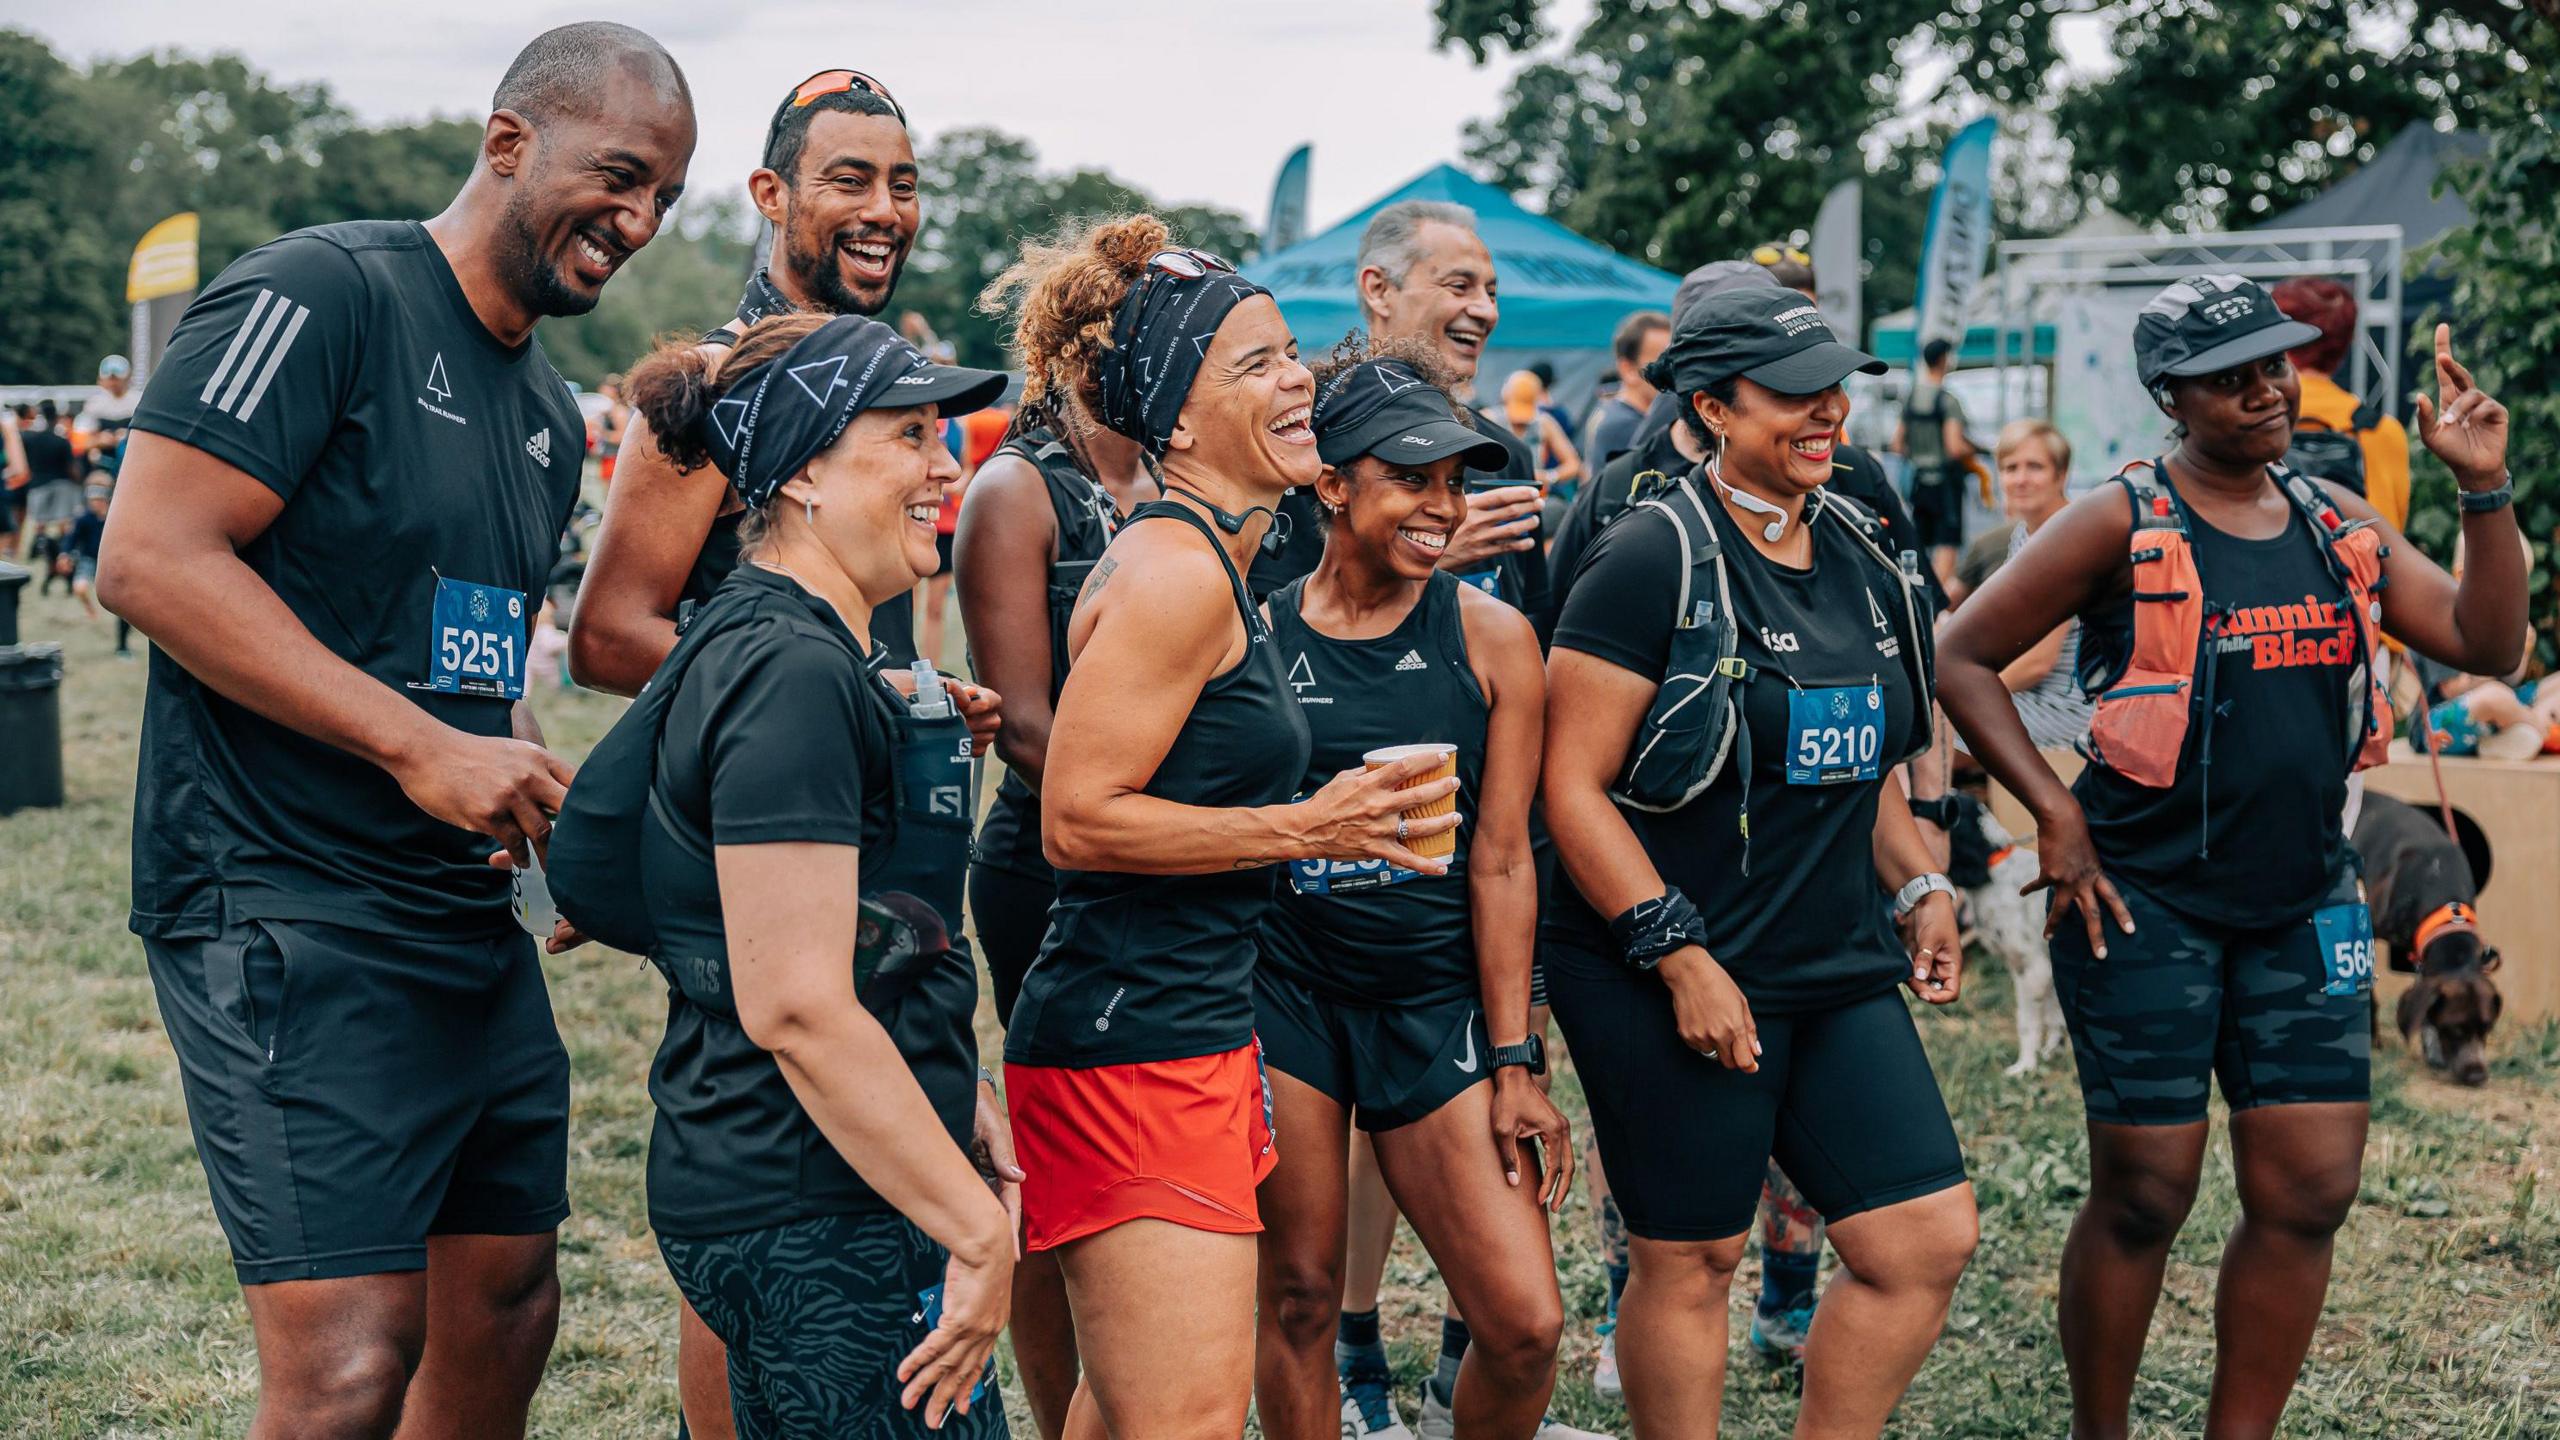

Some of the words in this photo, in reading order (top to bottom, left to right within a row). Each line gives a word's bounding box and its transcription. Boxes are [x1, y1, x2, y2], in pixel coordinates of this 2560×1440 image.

[1773, 305, 1819, 323] THRESHOL
[845, 380, 866, 415] TRAIL
[862, 343, 890, 384] RUNNERS
[1148, 379, 1163, 403] TRAIL
[1160, 336, 1180, 379] RUNNERS
[749, 372, 771, 428] RUNNERS
[1318, 389, 1333, 413] TRAIL
[442, 411, 467, 425] RUNNERS
[526, 441, 550, 468] adidas
[742, 424, 754, 459] TRAIL
[1401, 435, 1434, 447] 2XU
[738, 459, 750, 489] BLACK
[441, 626, 515, 677] 5251
[1395, 662, 1428, 671] adidas
[1798, 725, 1877, 767] 5210
[2335, 938, 2376, 978] 564
